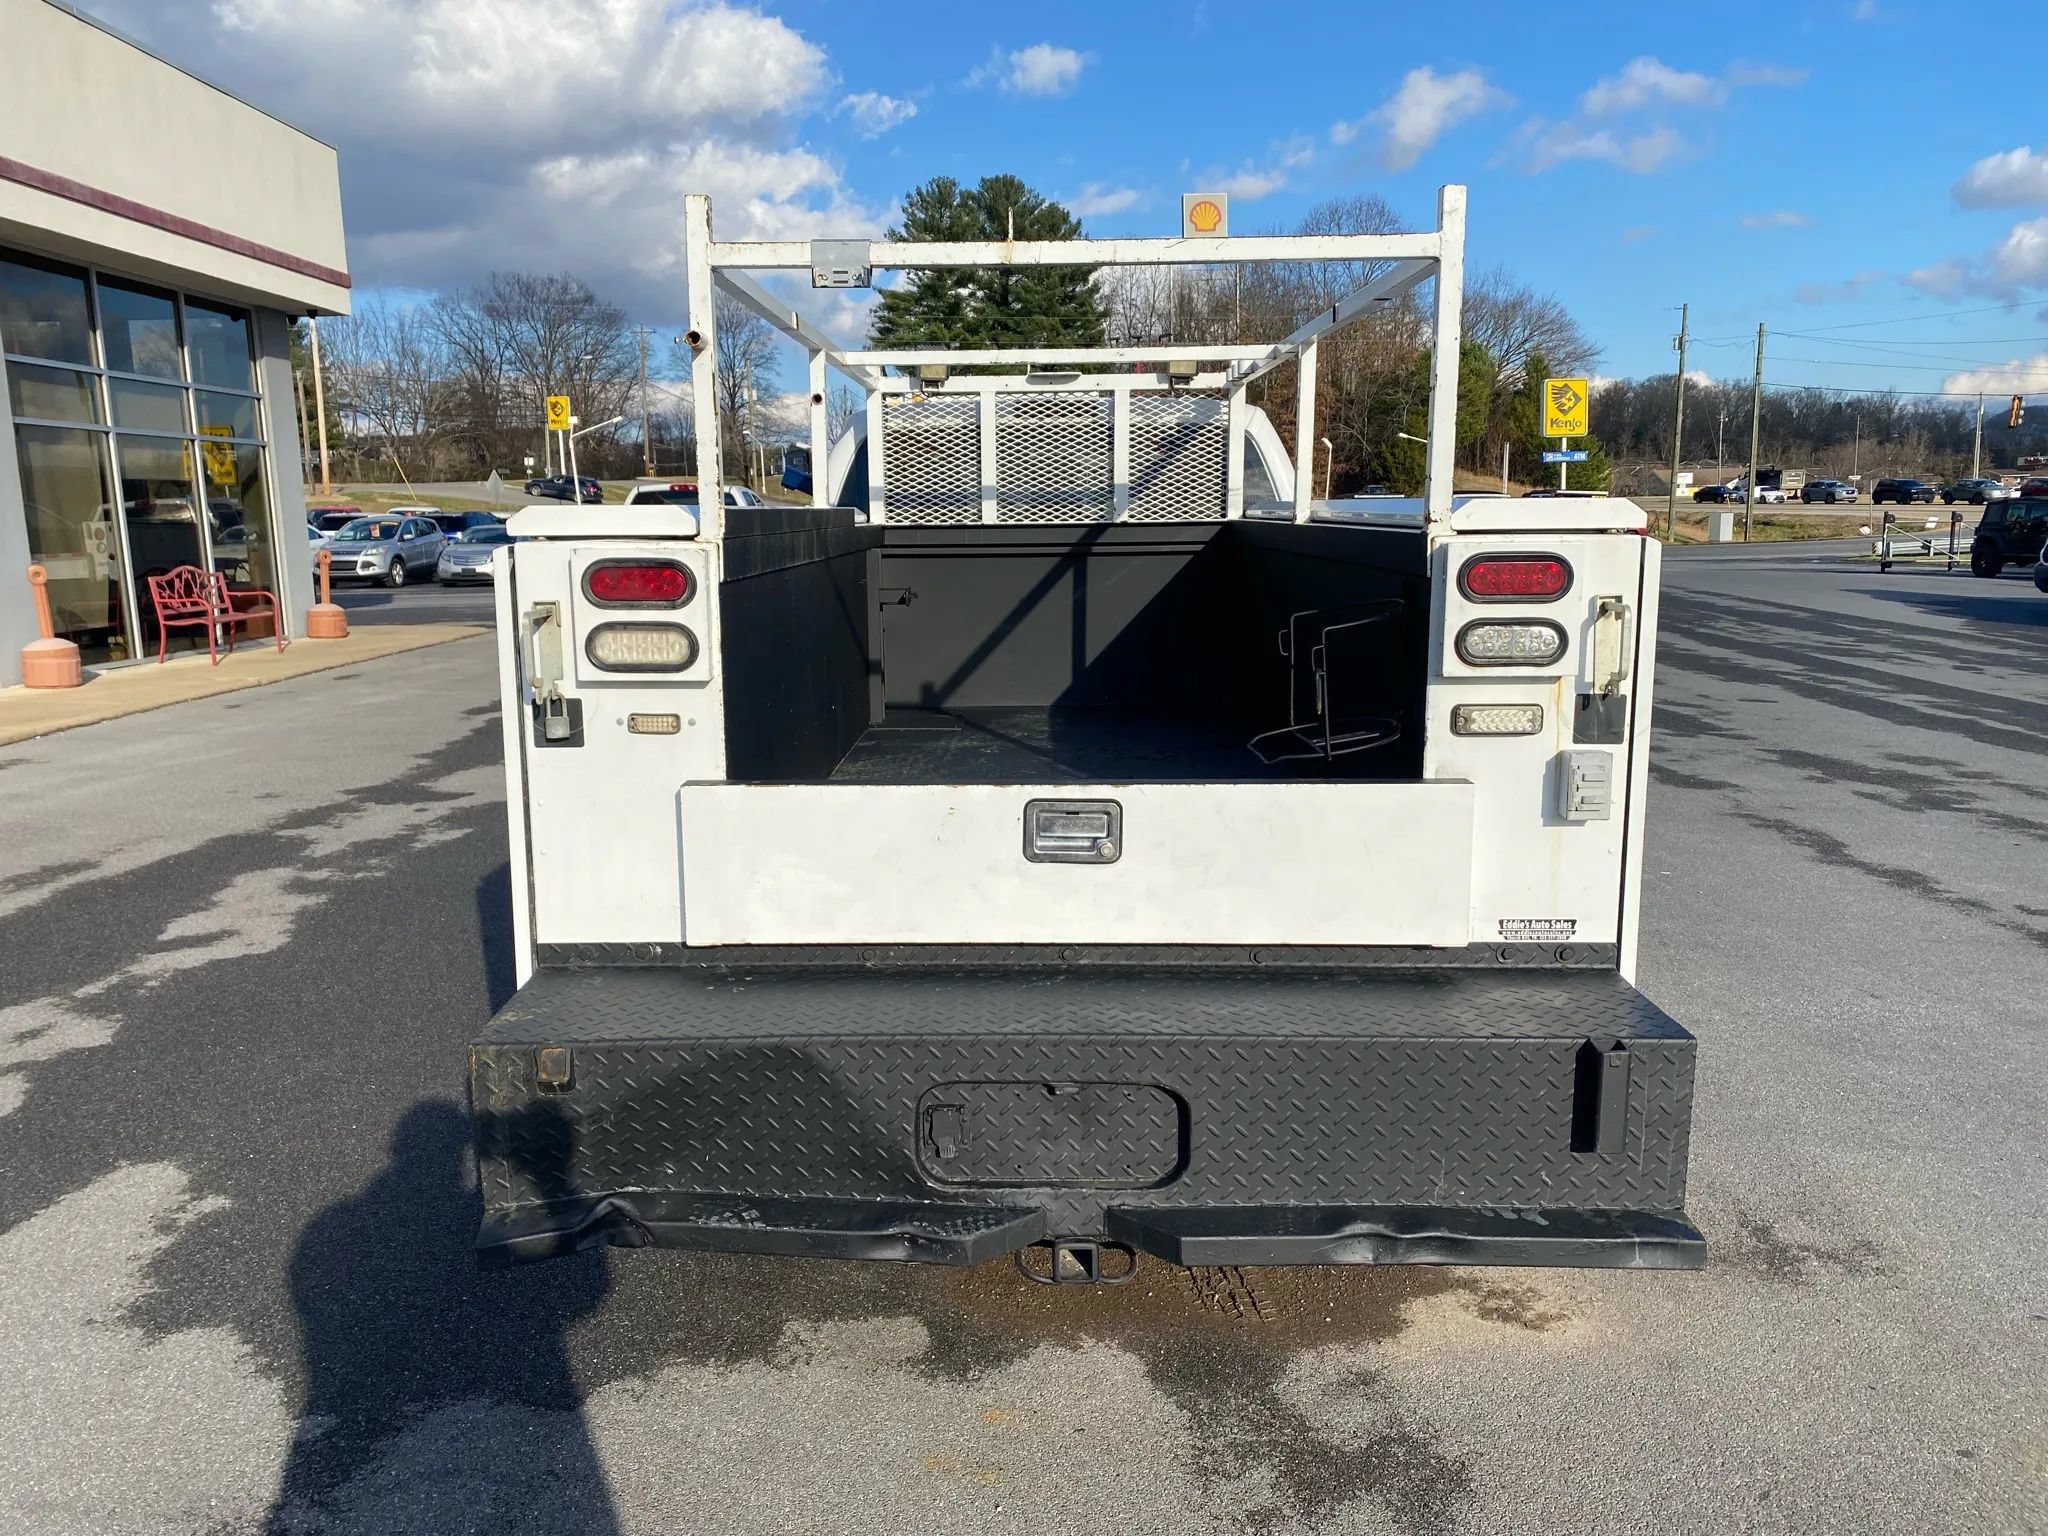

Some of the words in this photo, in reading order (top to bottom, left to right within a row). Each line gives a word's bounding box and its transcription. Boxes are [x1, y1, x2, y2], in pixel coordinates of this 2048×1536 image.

[1550, 418, 1582, 432] Kenjo
[1502, 919, 1530, 929] Eddie's
[1530, 919, 1550, 929] Auto
[1551, 919, 1572, 929] Sales
